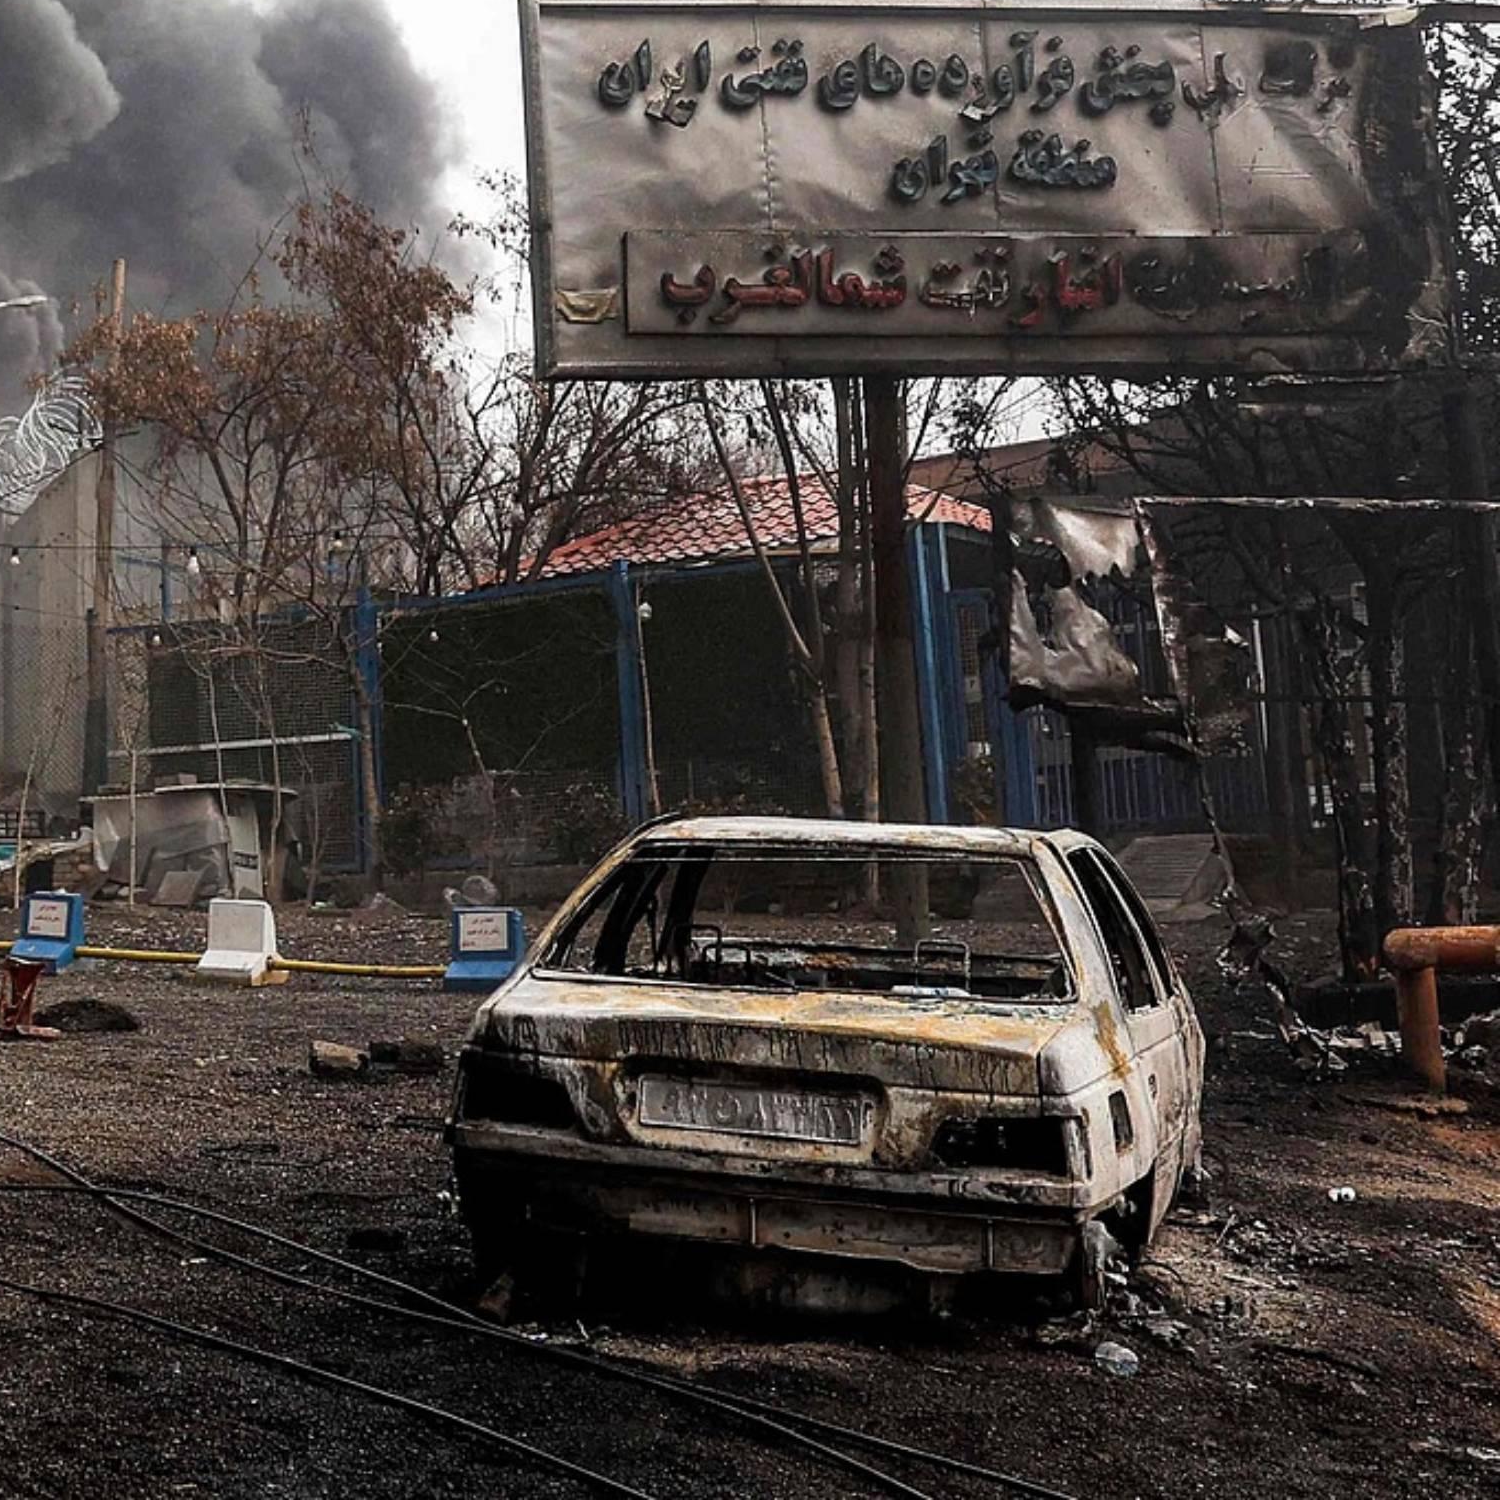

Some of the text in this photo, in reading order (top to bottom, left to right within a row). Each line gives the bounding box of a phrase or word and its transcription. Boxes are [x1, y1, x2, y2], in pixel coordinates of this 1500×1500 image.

[718, 38, 808, 107] نفتی
[816, 42, 906, 110] های
[1074, 43, 1176, 128] پخش
[892, 128, 1117, 206] منطقه تهران
